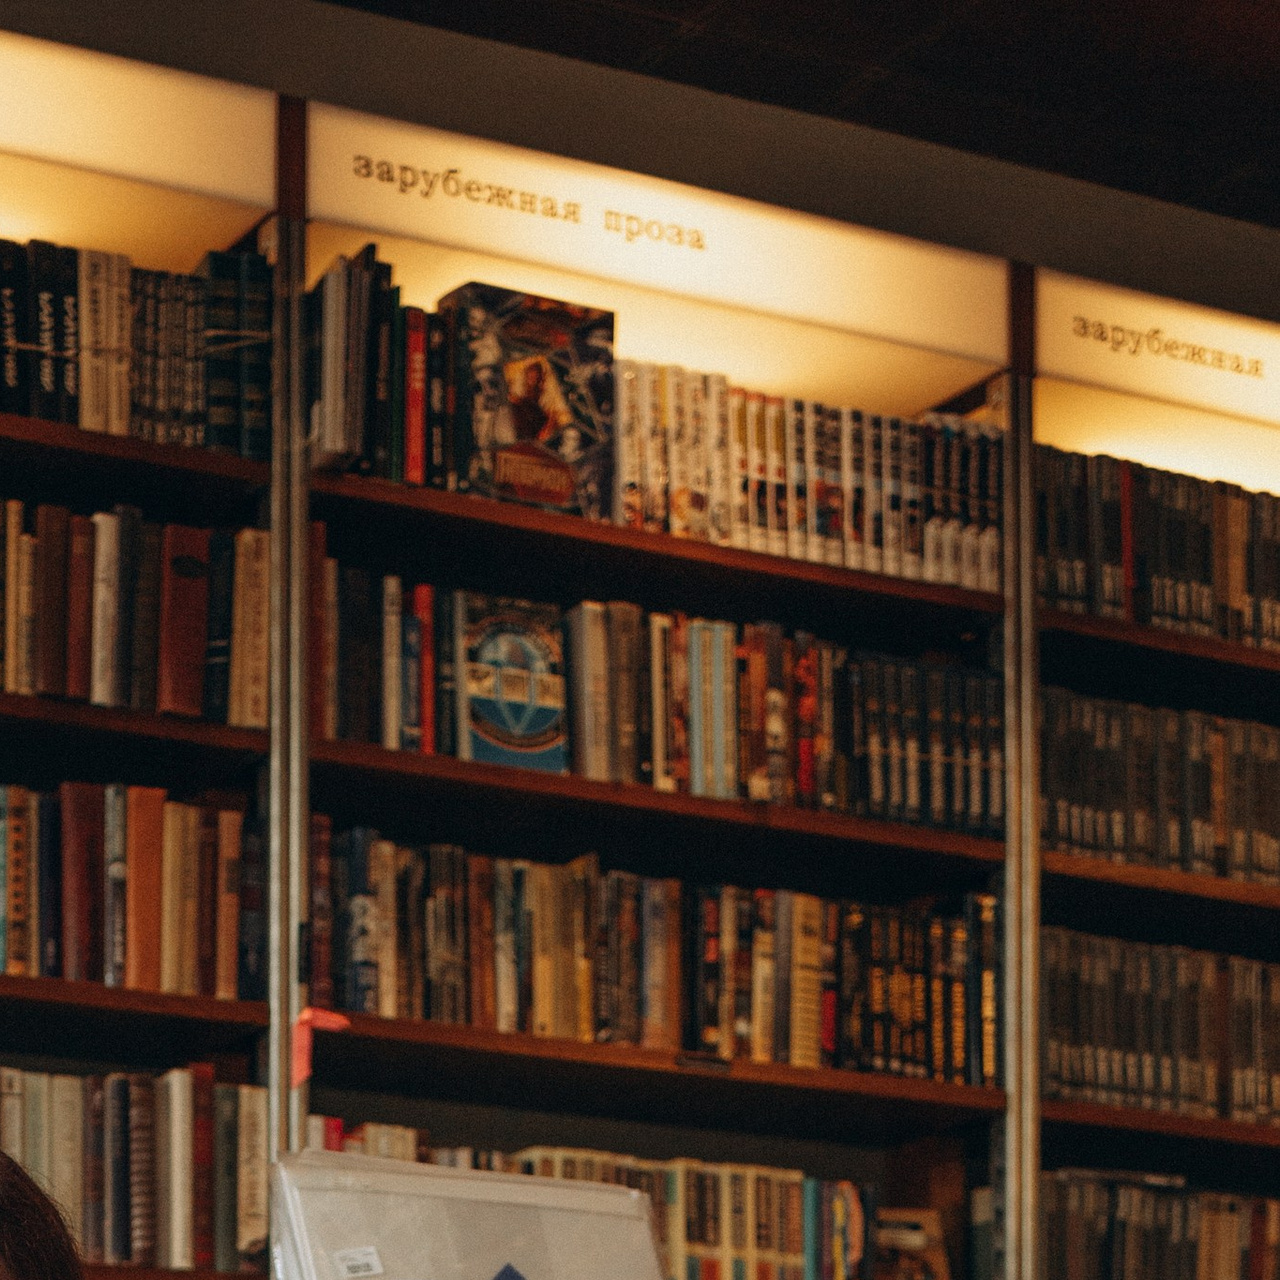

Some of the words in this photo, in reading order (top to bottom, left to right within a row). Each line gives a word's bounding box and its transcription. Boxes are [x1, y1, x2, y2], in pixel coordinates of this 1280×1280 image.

[353, 154, 582, 225] зарубежная
[604, 208, 706, 252] проза
[1073, 315, 1264, 379] зарубежная
